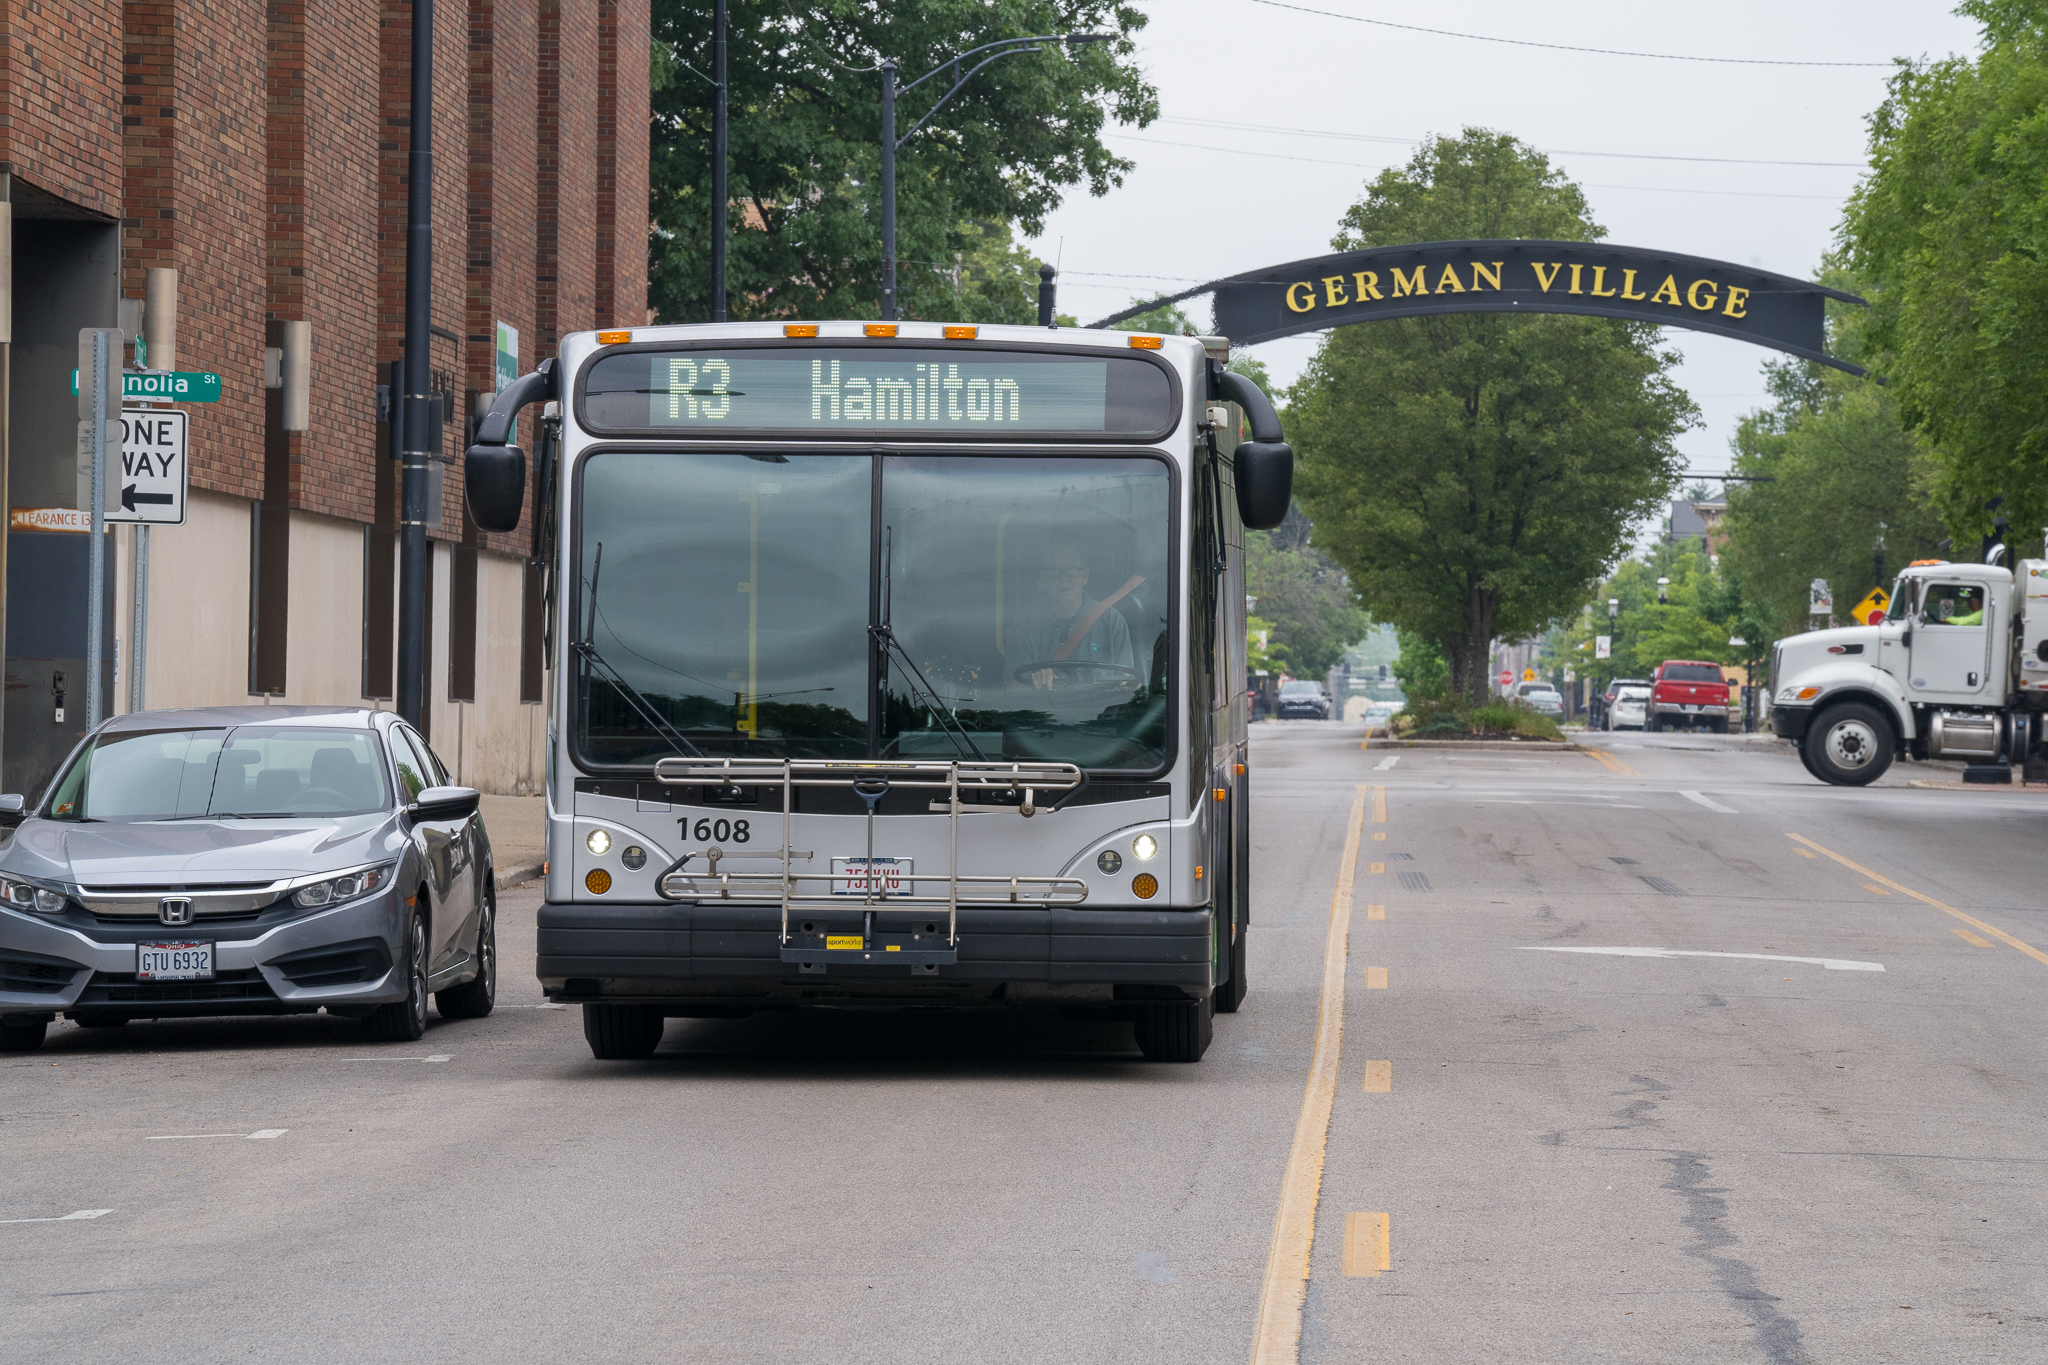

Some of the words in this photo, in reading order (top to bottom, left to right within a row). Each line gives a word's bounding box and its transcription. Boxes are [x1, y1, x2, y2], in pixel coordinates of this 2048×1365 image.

[1285, 261, 1505, 314] GERMAN
[1530, 261, 1750, 319] VILLAGE
[204, 375, 216, 384] St
[669, 358, 730, 419] R3
[812, 359, 1019, 421] Hamilton
[17, 512, 77, 525] CLEARANCE
[676, 817, 750, 843] 1608
[143, 952, 169, 971] GTU
[173, 951, 208, 970] 6932
